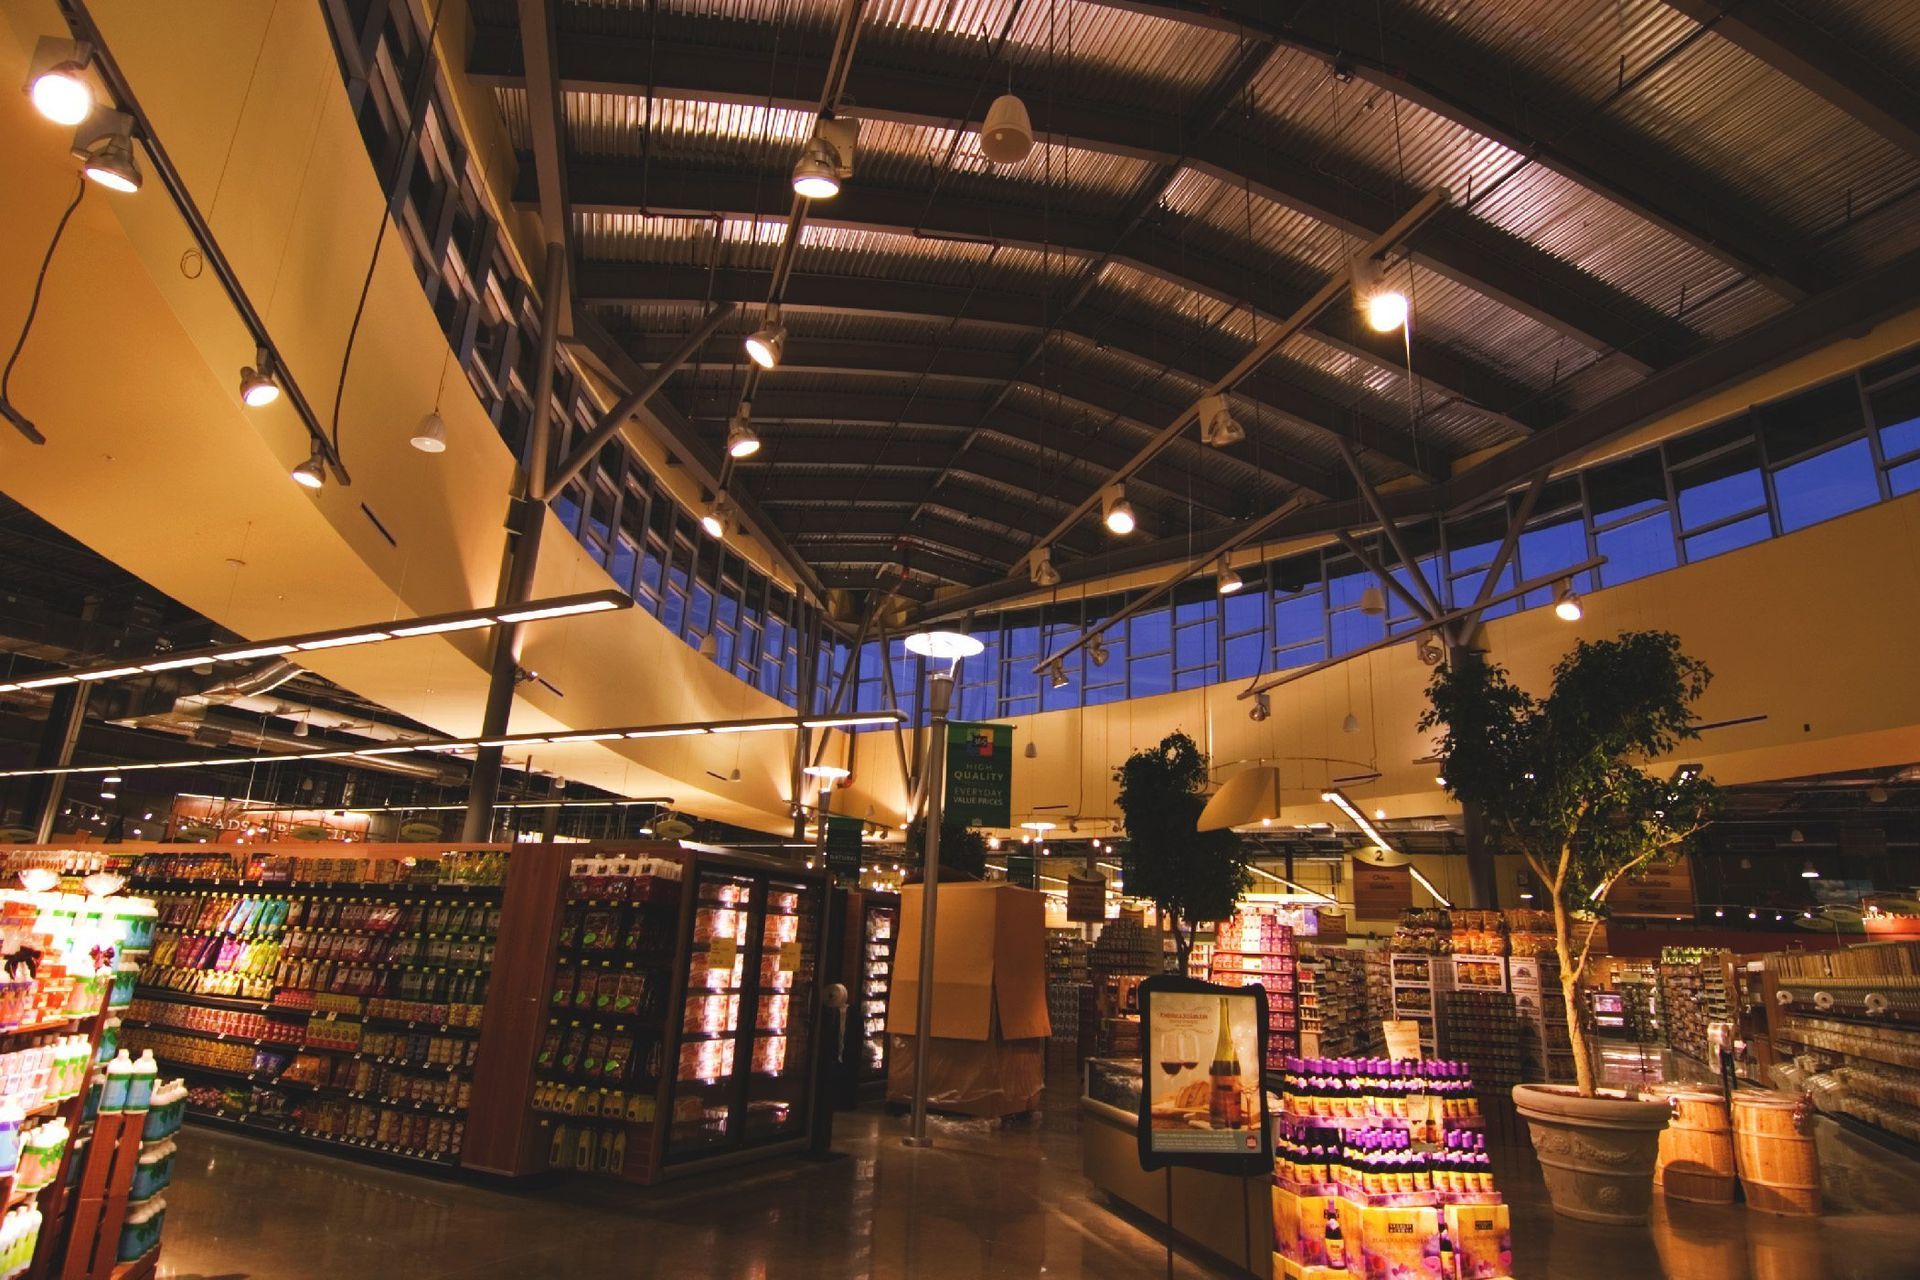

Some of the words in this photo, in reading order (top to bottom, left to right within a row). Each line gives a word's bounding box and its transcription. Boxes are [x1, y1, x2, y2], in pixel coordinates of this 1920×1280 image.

[954, 771, 1003, 781] QUALITY
[954, 787, 1002, 797] EVERYDAY
[953, 796, 976, 804] VALUE
[977, 797, 1003, 806] PRICES
[1375, 850, 1384, 861] 2
